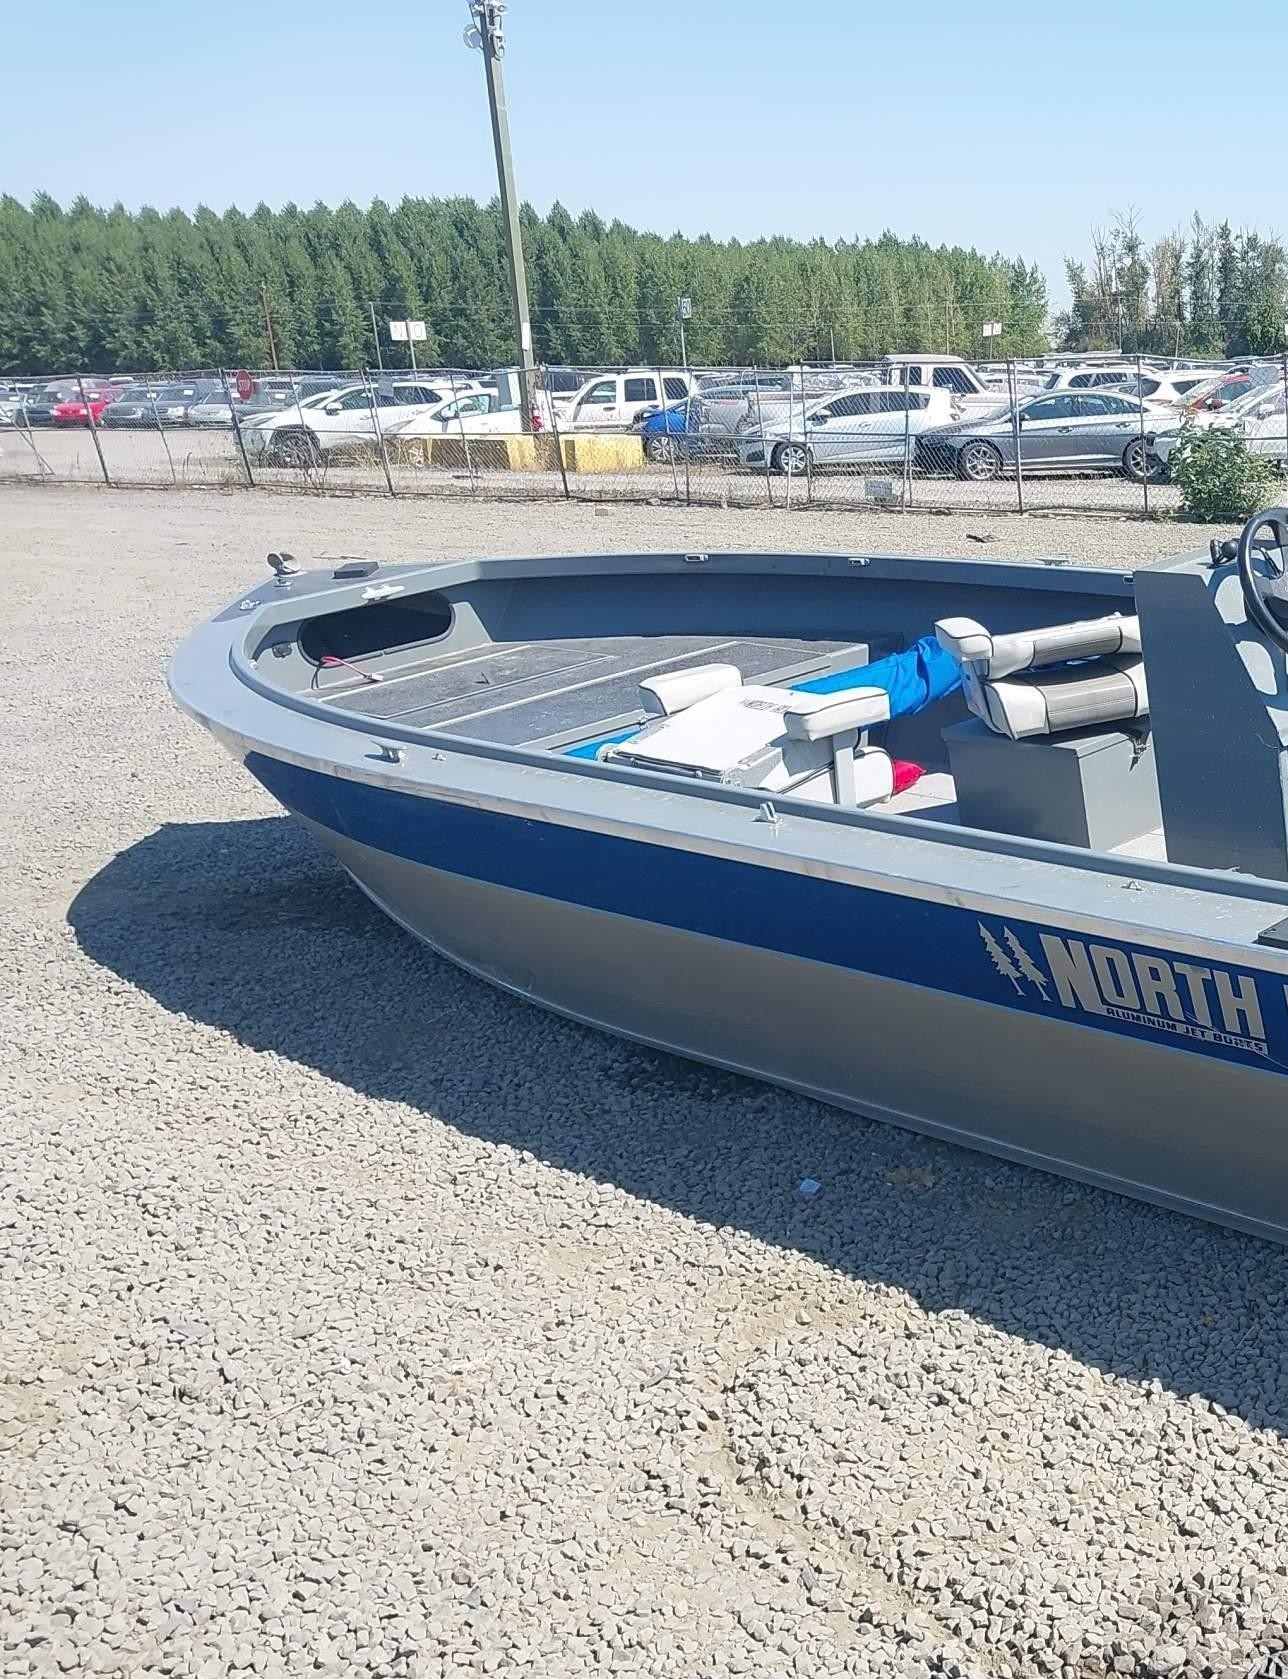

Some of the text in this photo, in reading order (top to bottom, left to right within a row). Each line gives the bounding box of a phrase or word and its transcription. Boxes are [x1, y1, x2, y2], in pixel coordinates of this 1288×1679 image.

[238, 379, 251, 391] STOP
[1039, 933, 1266, 1040] NORTH
[1105, 1006, 1178, 1031] ALUMINUM
[1182, 1026, 1207, 1041] JET
